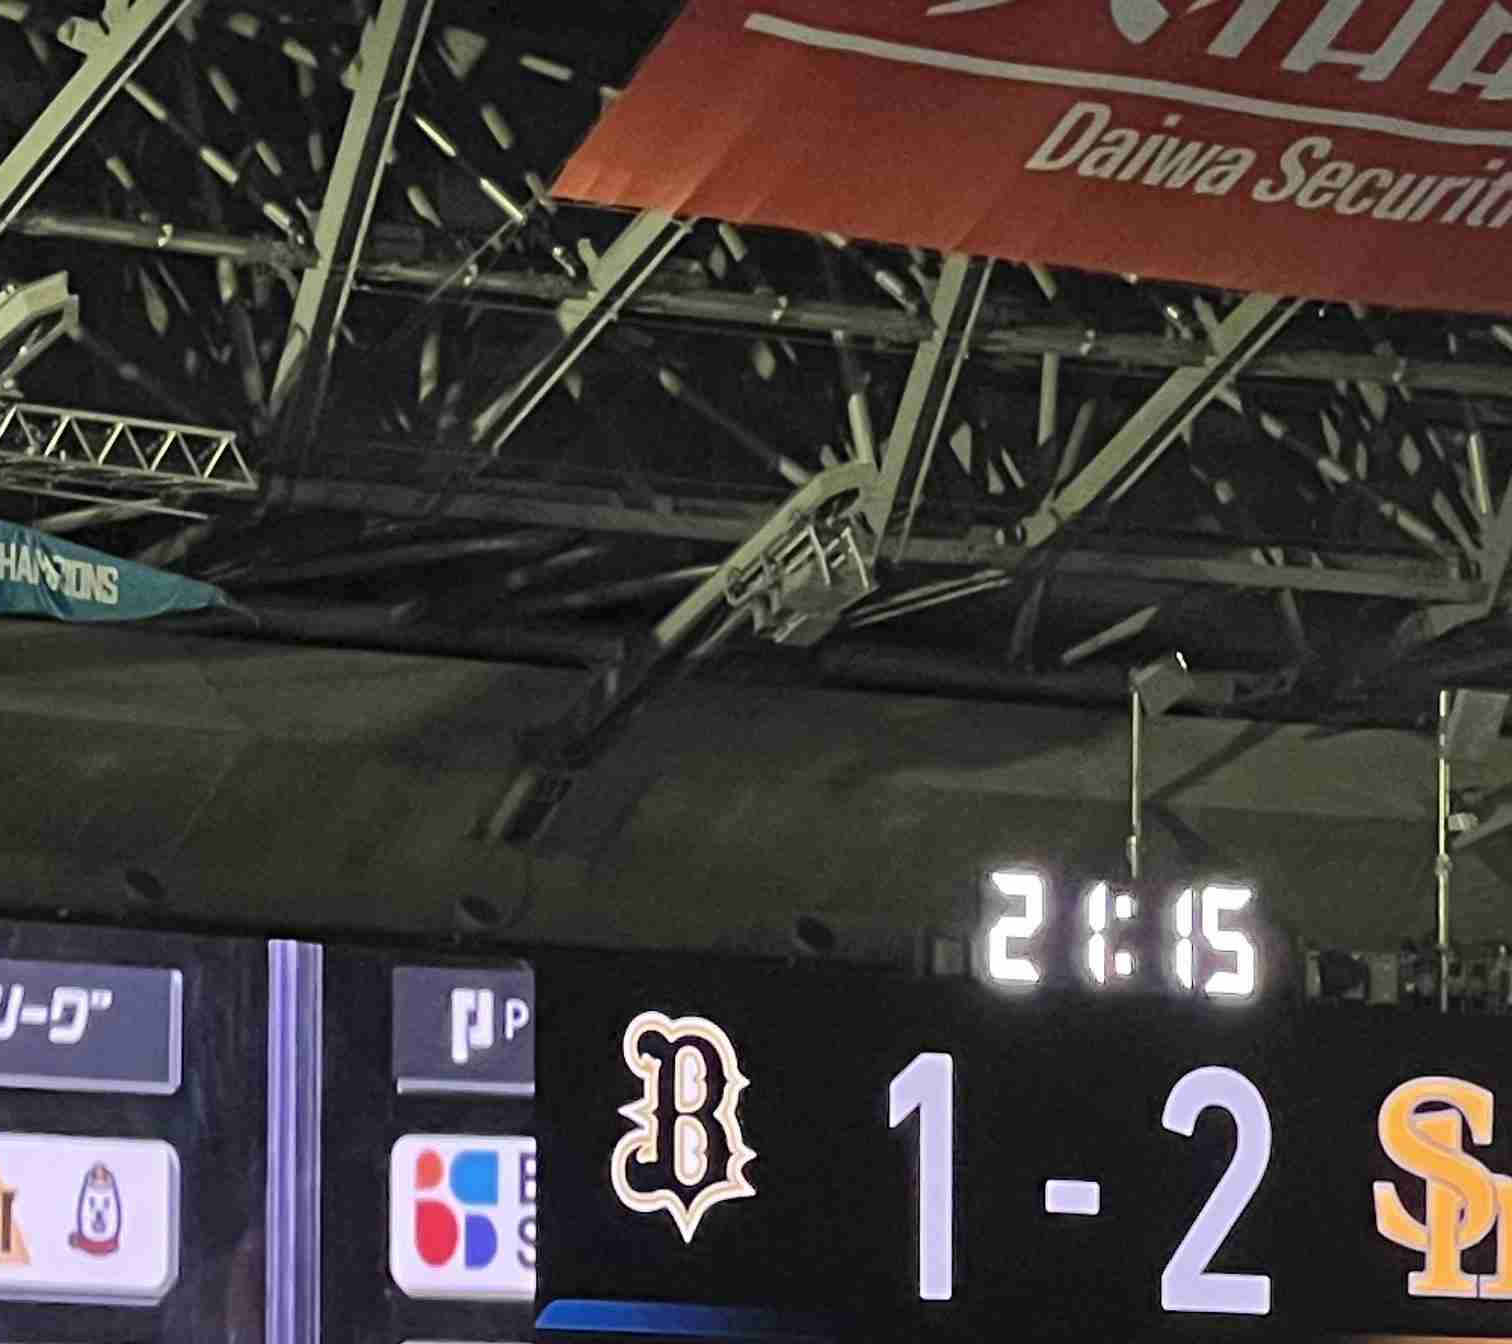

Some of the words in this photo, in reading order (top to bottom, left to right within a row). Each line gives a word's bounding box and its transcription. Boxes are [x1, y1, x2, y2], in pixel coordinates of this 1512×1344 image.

[1024, 100, 1256, 196] Daiwa
[986, 870, 1259, 998] 21:15
[889, 1052, 953, 1300] 1
[1161, 1066, 1272, 1315] 2
